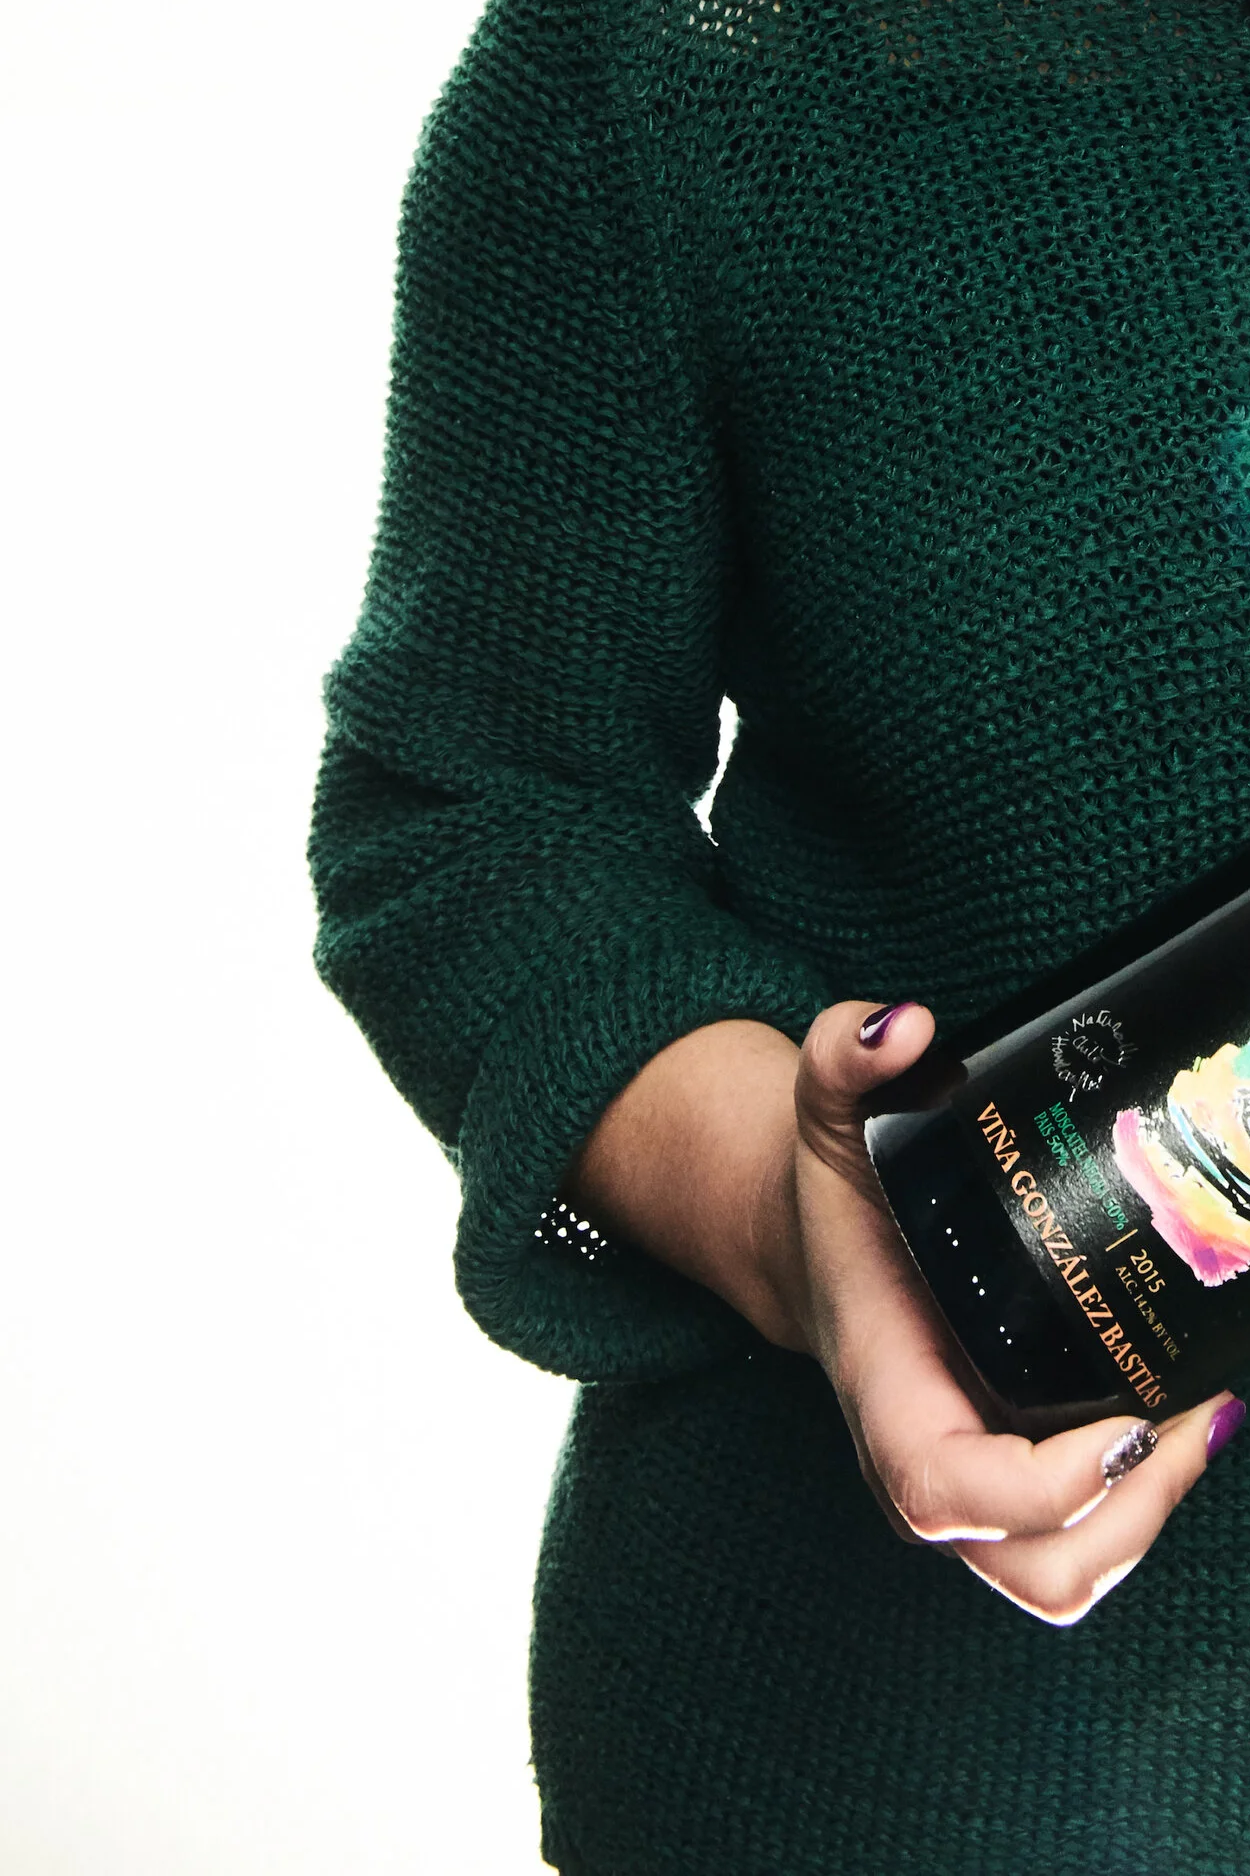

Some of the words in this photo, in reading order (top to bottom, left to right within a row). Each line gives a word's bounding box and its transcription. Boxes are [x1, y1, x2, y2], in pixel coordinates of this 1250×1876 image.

[1034, 1111, 1056, 1137] PAIS
[1046, 1135, 1071, 1167] 50%
[1049, 1102, 1089, 1162] MOSCATEL
[1103, 1197, 1129, 1231] 50%
[977, 1101, 1021, 1173] VIÑA
[1011, 1170, 1114, 1328] GONZÁLEZ
[1099, 1322, 1168, 1409] BASTÍAS
[1130, 1248, 1166, 1293] 2015
[1115, 1266, 1138, 1295] ALC.
[1133, 1293, 1157, 1325] 14.2%
[1152, 1322, 1168, 1339] BY
